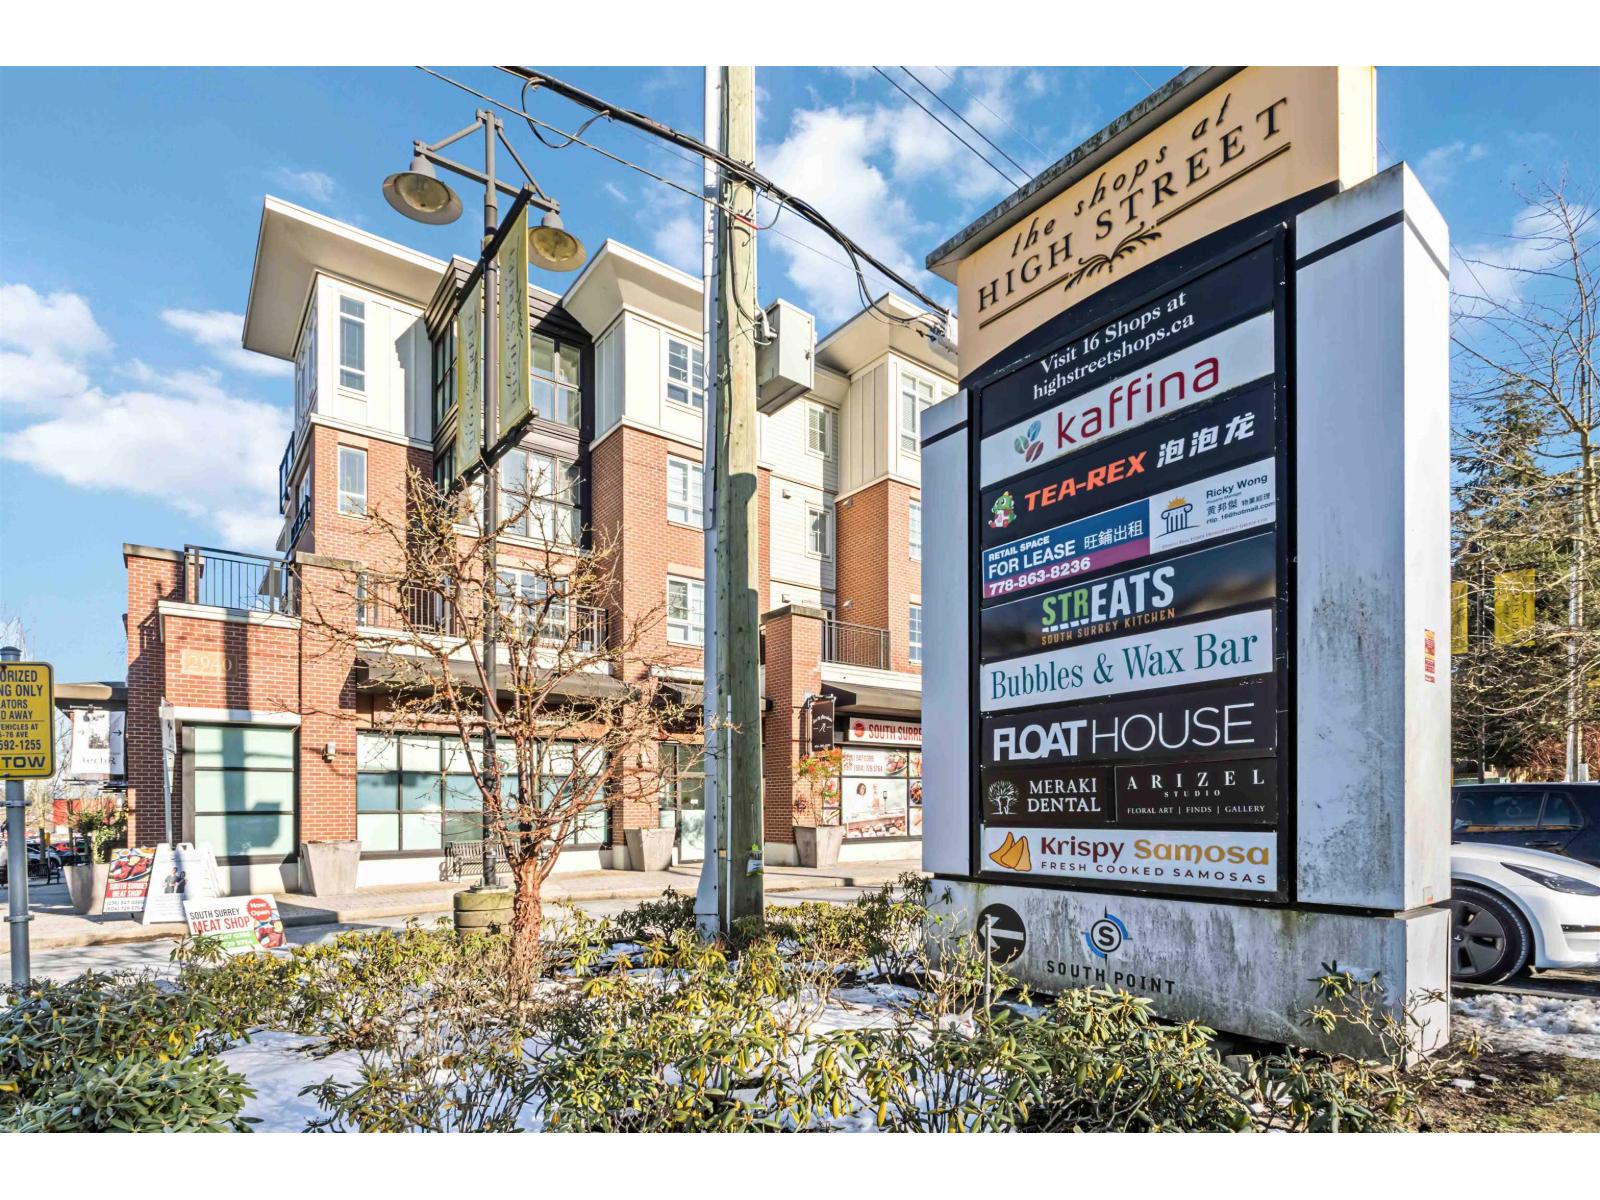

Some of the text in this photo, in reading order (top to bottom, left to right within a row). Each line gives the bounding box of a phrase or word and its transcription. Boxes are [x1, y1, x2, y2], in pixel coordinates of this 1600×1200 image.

[1011, 92, 1232, 258] the shops at
[978, 97, 1287, 312] HIGH STREET
[1040, 292, 1187, 375] Visit 16 Shops at
[1033, 314, 1195, 400] highstreetshops.ca
[1057, 357, 1219, 449] kaffina
[1156, 412, 1255, 468] 泡泡龙
[1025, 451, 1147, 512] TEA-REX
[1206, 475, 1268, 499] Ricky Wong
[989, 536, 1050, 562] RETAIL SPACE
[989, 540, 1076, 579] FOR LEASE
[989, 557, 1091, 596] 778-863-8236
[1041, 566, 1175, 626] STREATS
[1041, 608, 1175, 646] SOUTH SURREY KITCHEN
[991, 633, 1258, 700] Bubbles & Wax Bar
[15, 684, 43, 697] ONLY
[1, 723, 38, 731] EHICLES AT
[9, 711, 33, 720] AWAY
[868, 724, 896, 739] SOUTH
[993, 702, 1254, 761] FLOAT HOUSE
[1, 756, 46, 768] TOW
[1029, 778, 1097, 794] MERAKI
[1127, 769, 1265, 790] ARIZEL
[1027, 798, 1102, 813] DENTAL
[1164, 790, 1220, 798] STUDIO
[1158, 806, 1174, 814] ART
[1225, 805, 1265, 813] GALLERY
[1041, 835, 1269, 865] Krispy Samosa
[1041, 861, 1266, 884] FRESH COOKED SAMOSAS
[189, 908, 240, 920] SOUTH SURREY
[192, 916, 250, 934] MEAT SHOP
[1047, 960, 1175, 995] SOUTH POINT
